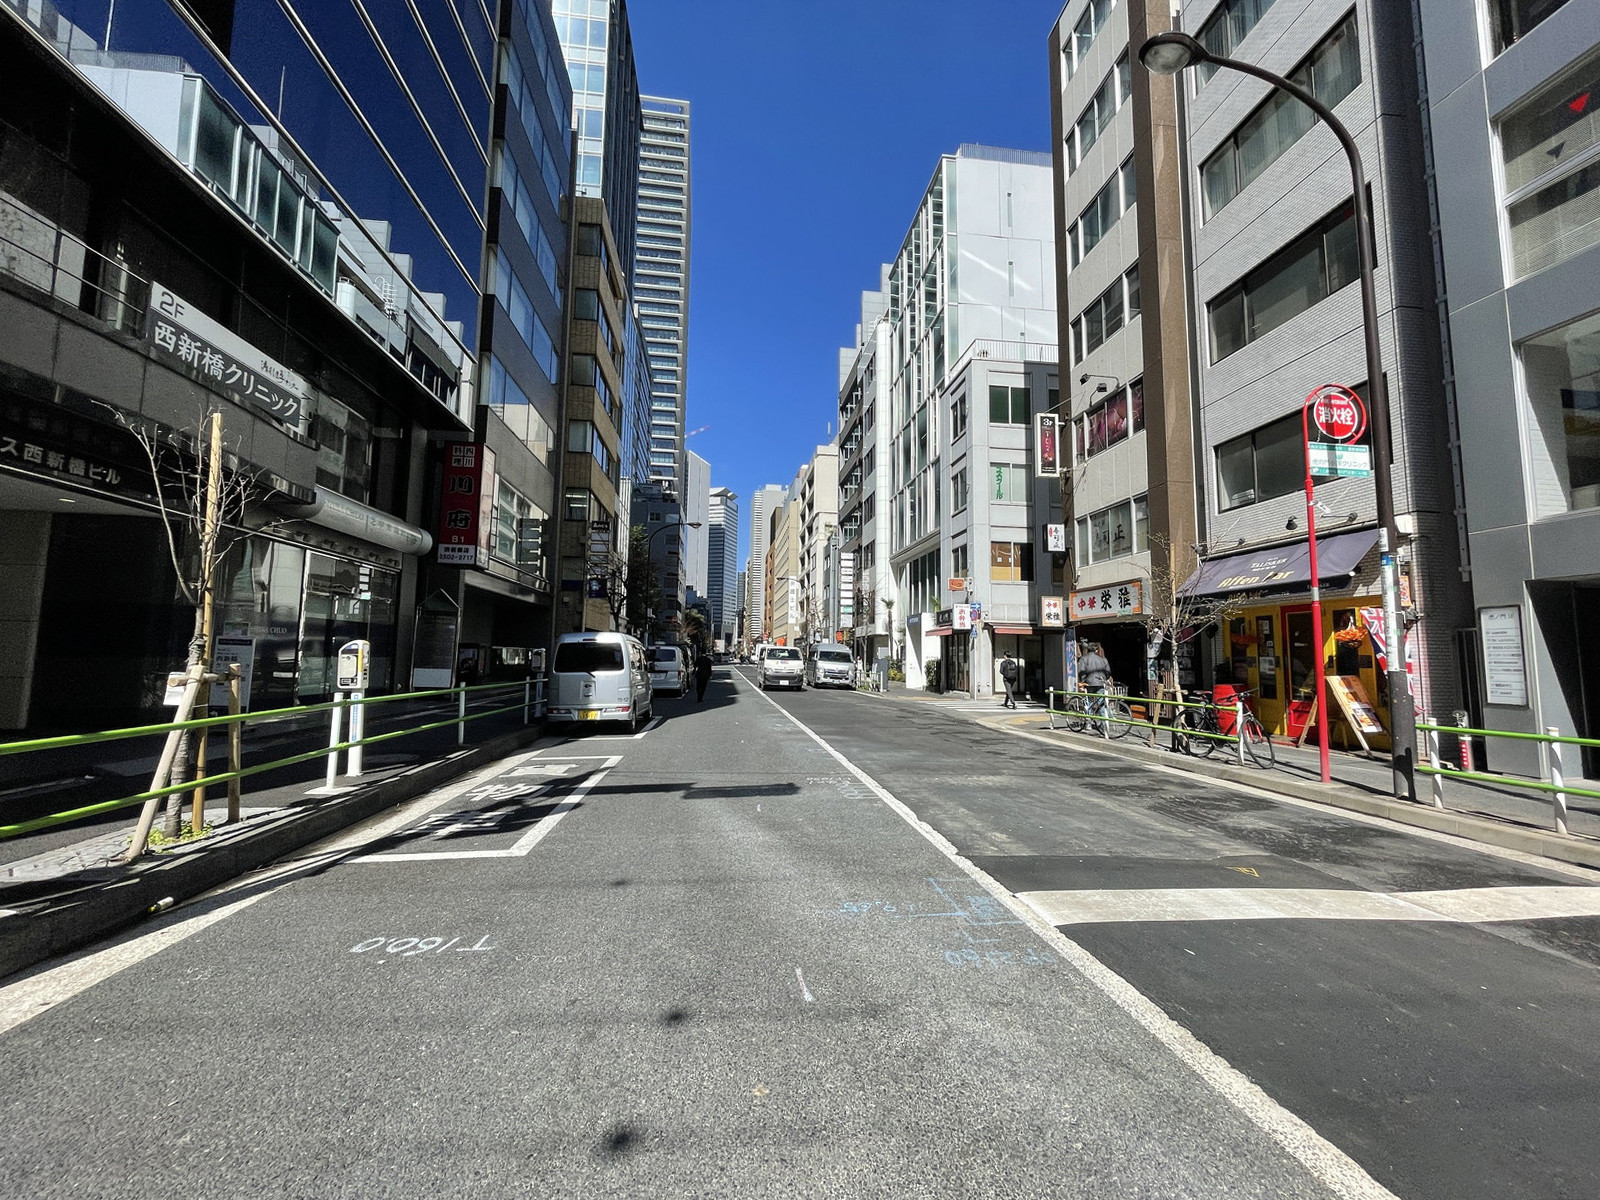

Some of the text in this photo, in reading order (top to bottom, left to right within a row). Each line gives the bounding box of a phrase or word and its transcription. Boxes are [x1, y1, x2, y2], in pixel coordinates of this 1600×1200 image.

[159, 291, 185, 318] 2F
[154, 320, 298, 417] 西新橋クリニック
[1318, 406, 1354, 425] 消火栓
[452, 535, 465, 543] B1
[1078, 596, 1097, 611] 中華
